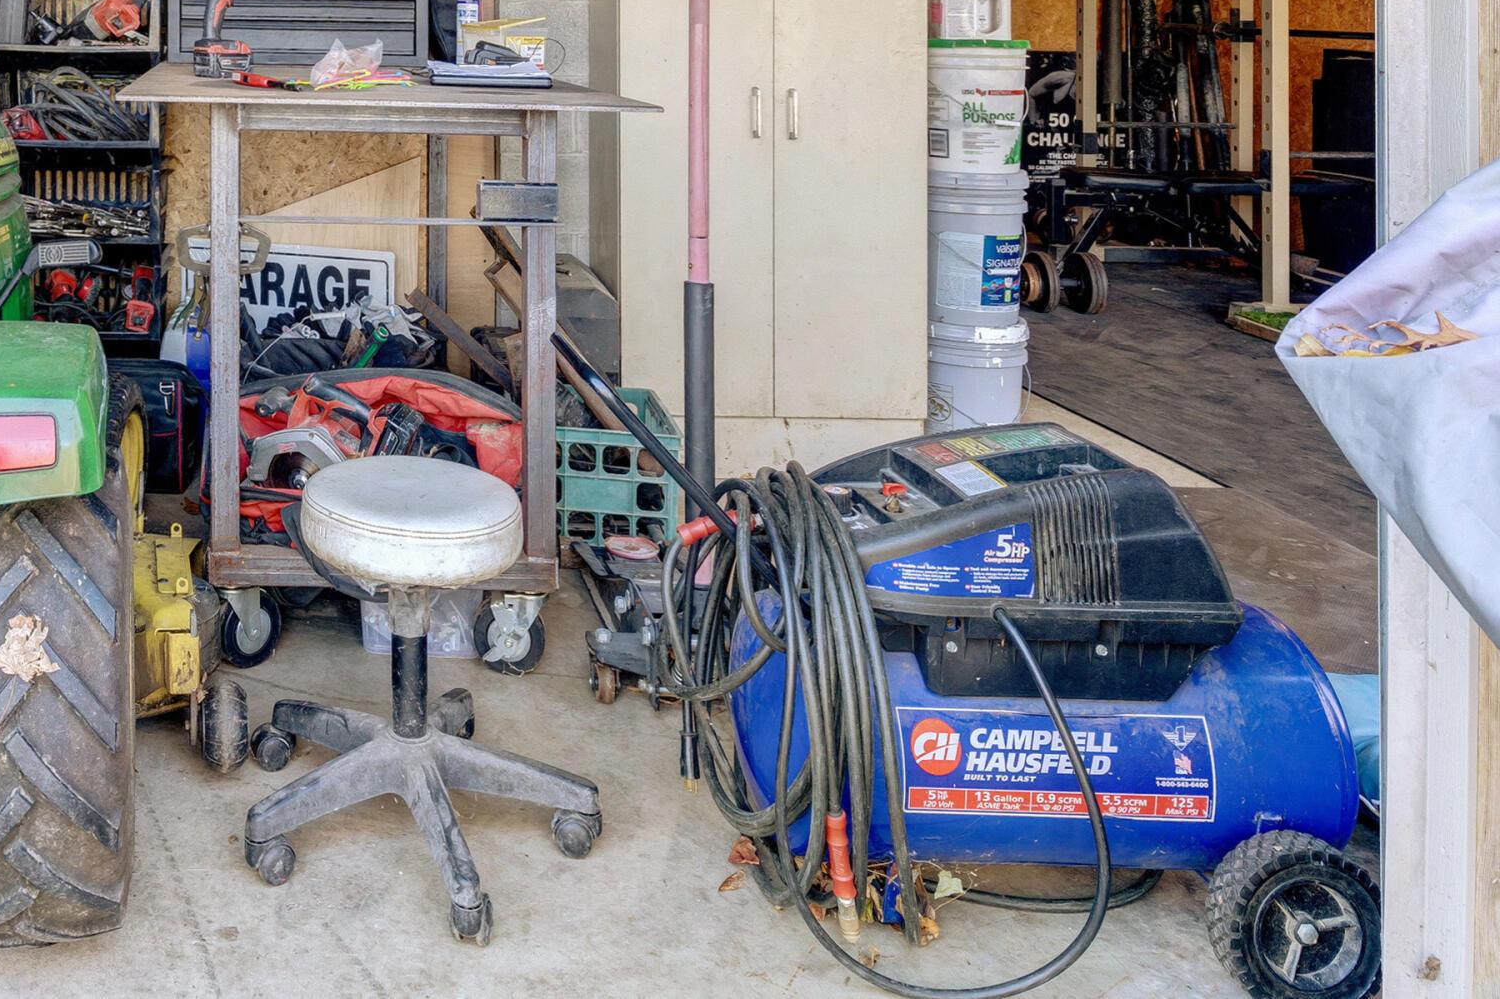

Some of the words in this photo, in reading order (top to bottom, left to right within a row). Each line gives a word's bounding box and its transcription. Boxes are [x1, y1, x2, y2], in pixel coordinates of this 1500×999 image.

[963, 101, 988, 112] ALL
[963, 112, 1016, 124] PURPOSE
[1048, 112, 1070, 128] 50
[986, 257, 1021, 269] SIGNATU
[238, 260, 372, 312] ARAGE
[995, 534, 1013, 558] 5
[1011, 546, 1031, 558] HP
[983, 556, 1024, 564] Compressor
[969, 727, 1119, 754] CAMPBELL
[1011, 775, 1037, 783] LAST
[927, 790, 937, 800] 5
[974, 791, 991, 802] 13
[993, 794, 1024, 803] Gallon
[1035, 793, 1056, 804] 6.9
[1058, 797, 1083, 805] SCFM
[923, 800, 938, 808] 120
[938, 800, 955, 808] Volt
[976, 801, 1001, 809] ASME
[1102, 795, 1122, 806] 5.5
[1123, 799, 1148, 807] SCFM
[1171, 797, 1194, 808] 125
[1117, 806, 1128, 814] 90
[1185, 808, 1199, 816] PSI
